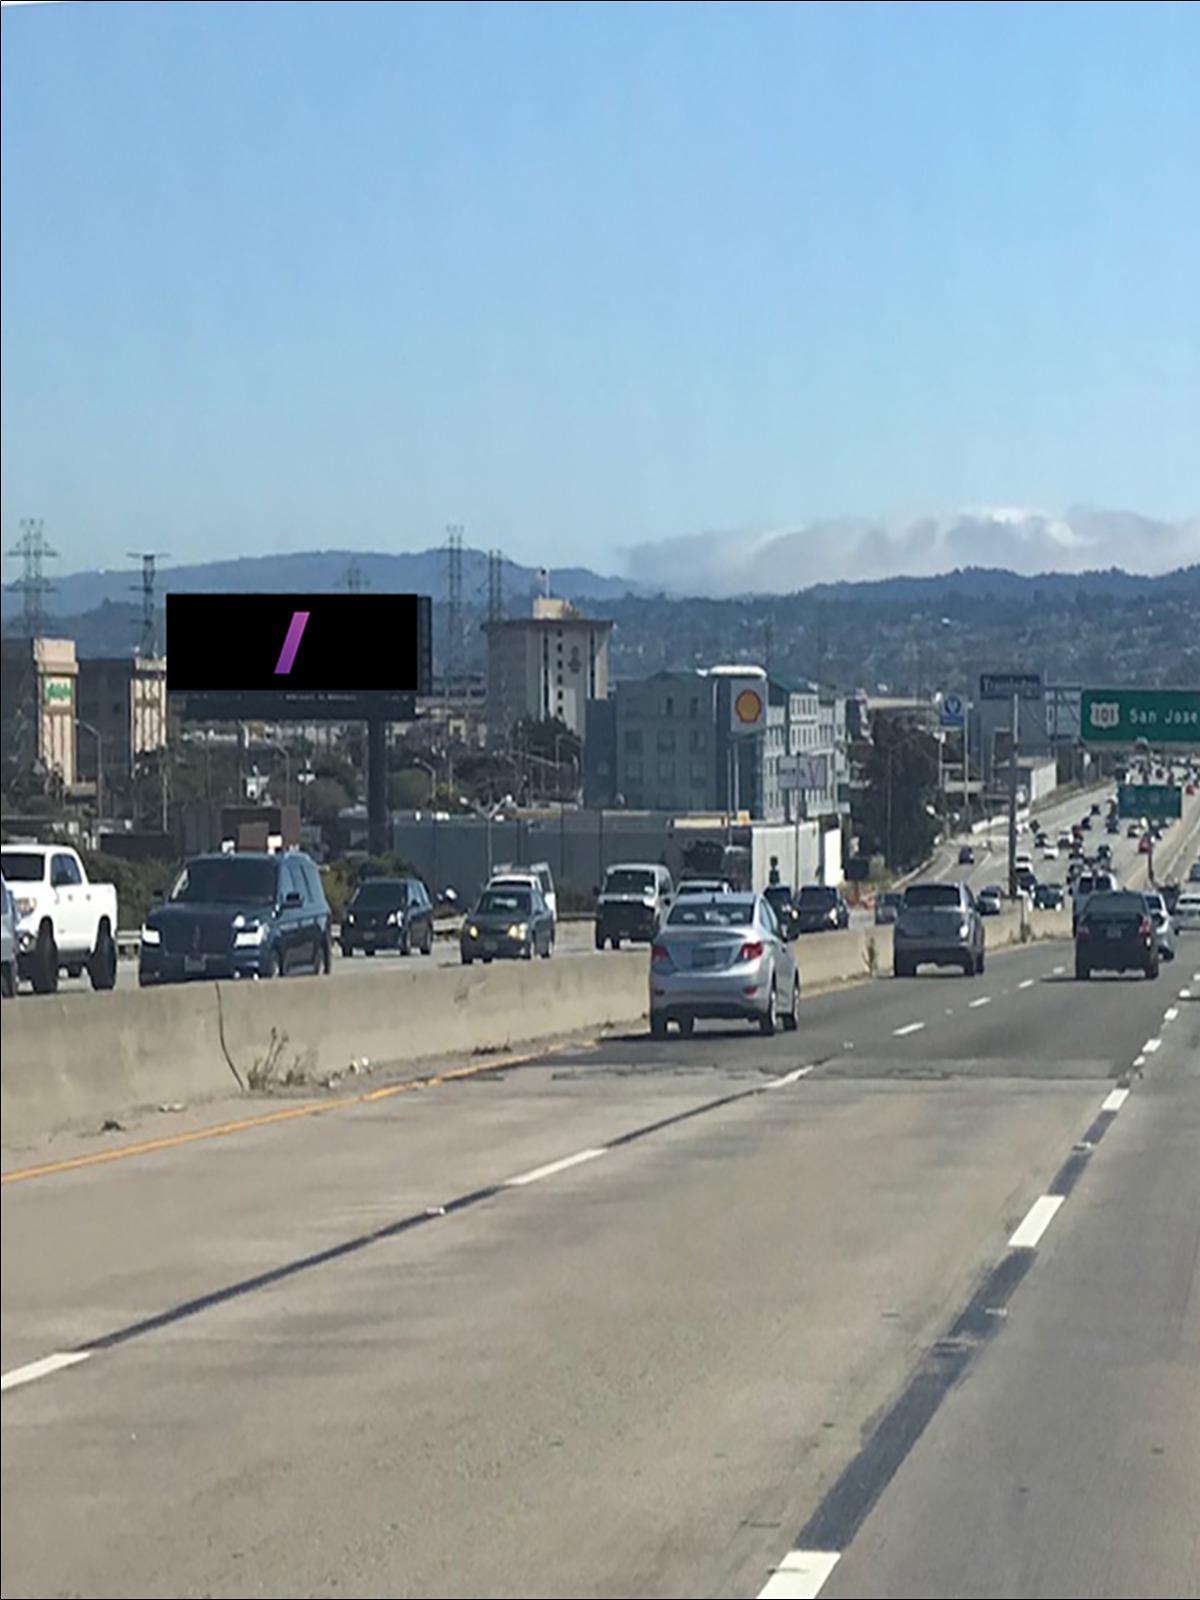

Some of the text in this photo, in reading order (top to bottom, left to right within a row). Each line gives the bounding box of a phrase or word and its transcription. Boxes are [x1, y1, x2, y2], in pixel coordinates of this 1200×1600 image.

[1095, 708, 1116, 721] 101
[1129, 708, 1198, 725] San Jose
